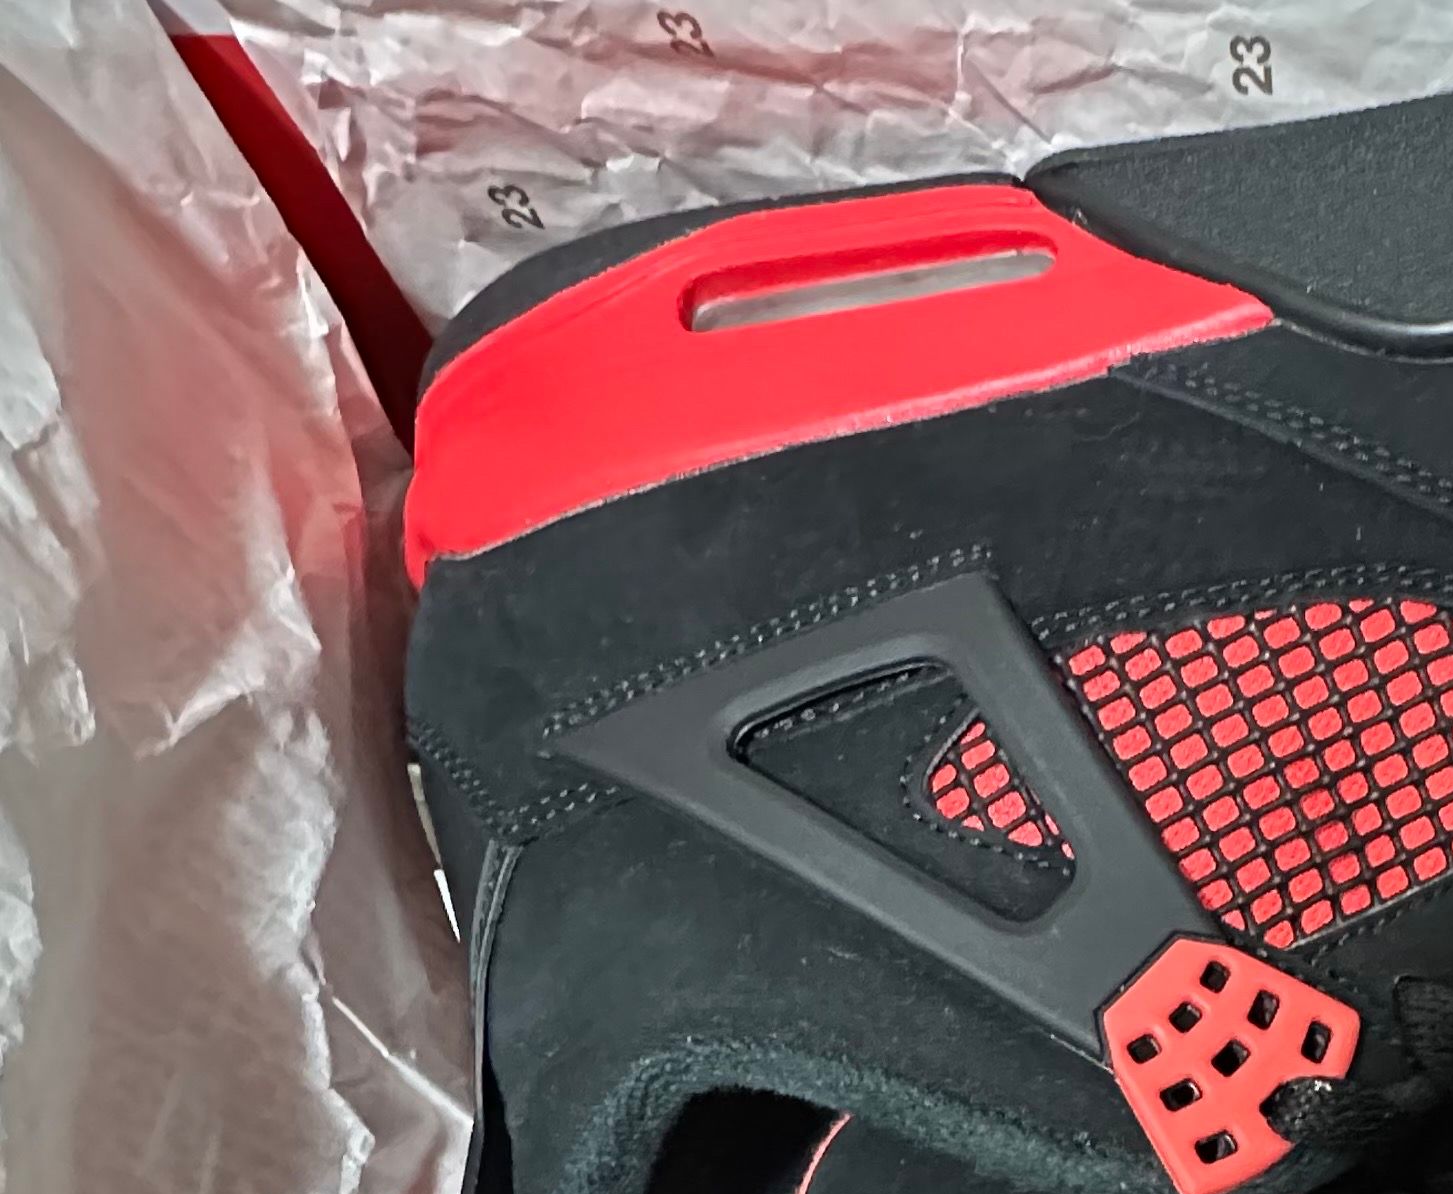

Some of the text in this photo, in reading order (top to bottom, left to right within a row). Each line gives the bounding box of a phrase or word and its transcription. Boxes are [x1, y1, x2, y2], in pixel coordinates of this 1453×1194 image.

[657, 12, 714, 58] 23
[1230, 36, 1273, 95] 23
[487, 185, 545, 230] 23
